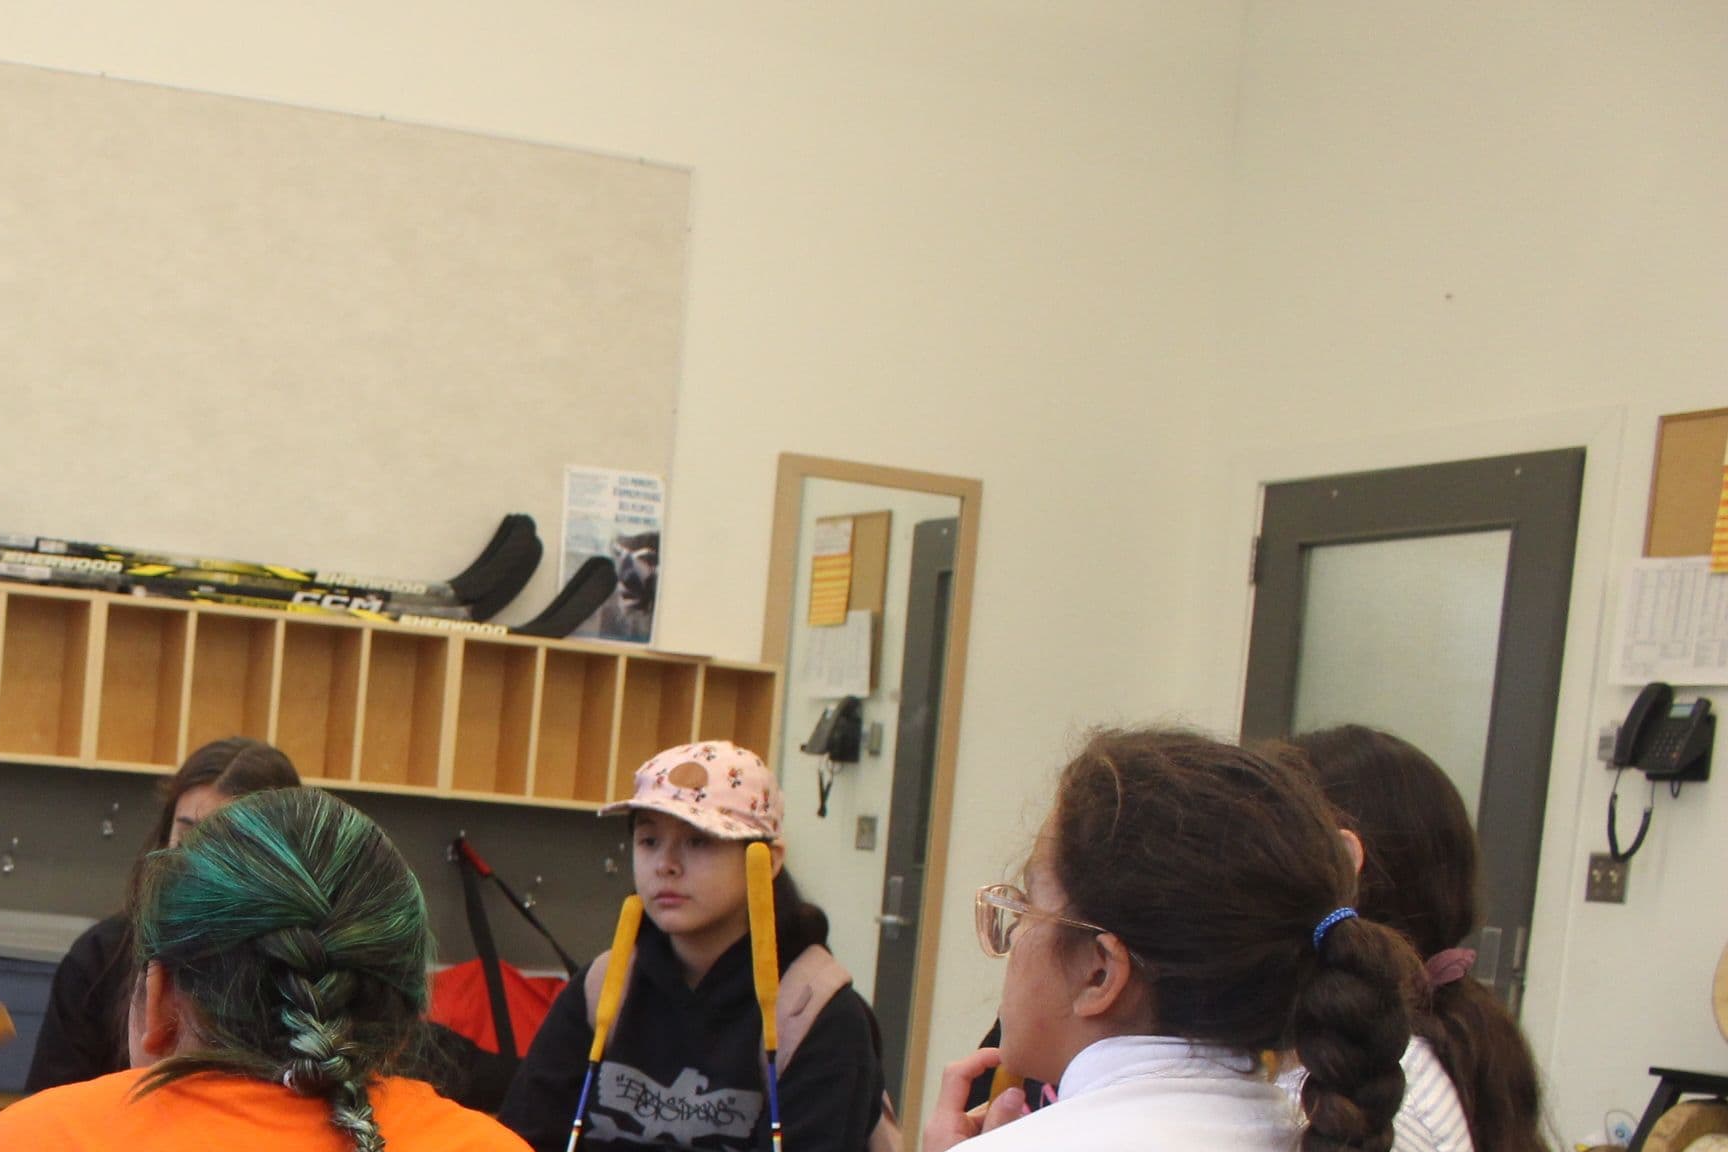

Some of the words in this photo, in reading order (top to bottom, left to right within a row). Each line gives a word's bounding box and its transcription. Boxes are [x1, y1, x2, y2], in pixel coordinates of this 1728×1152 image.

[1, 551, 123, 574] SHERWOOD
[292, 590, 384, 613] CCM
[399, 614, 509, 636] SHERWOOD
